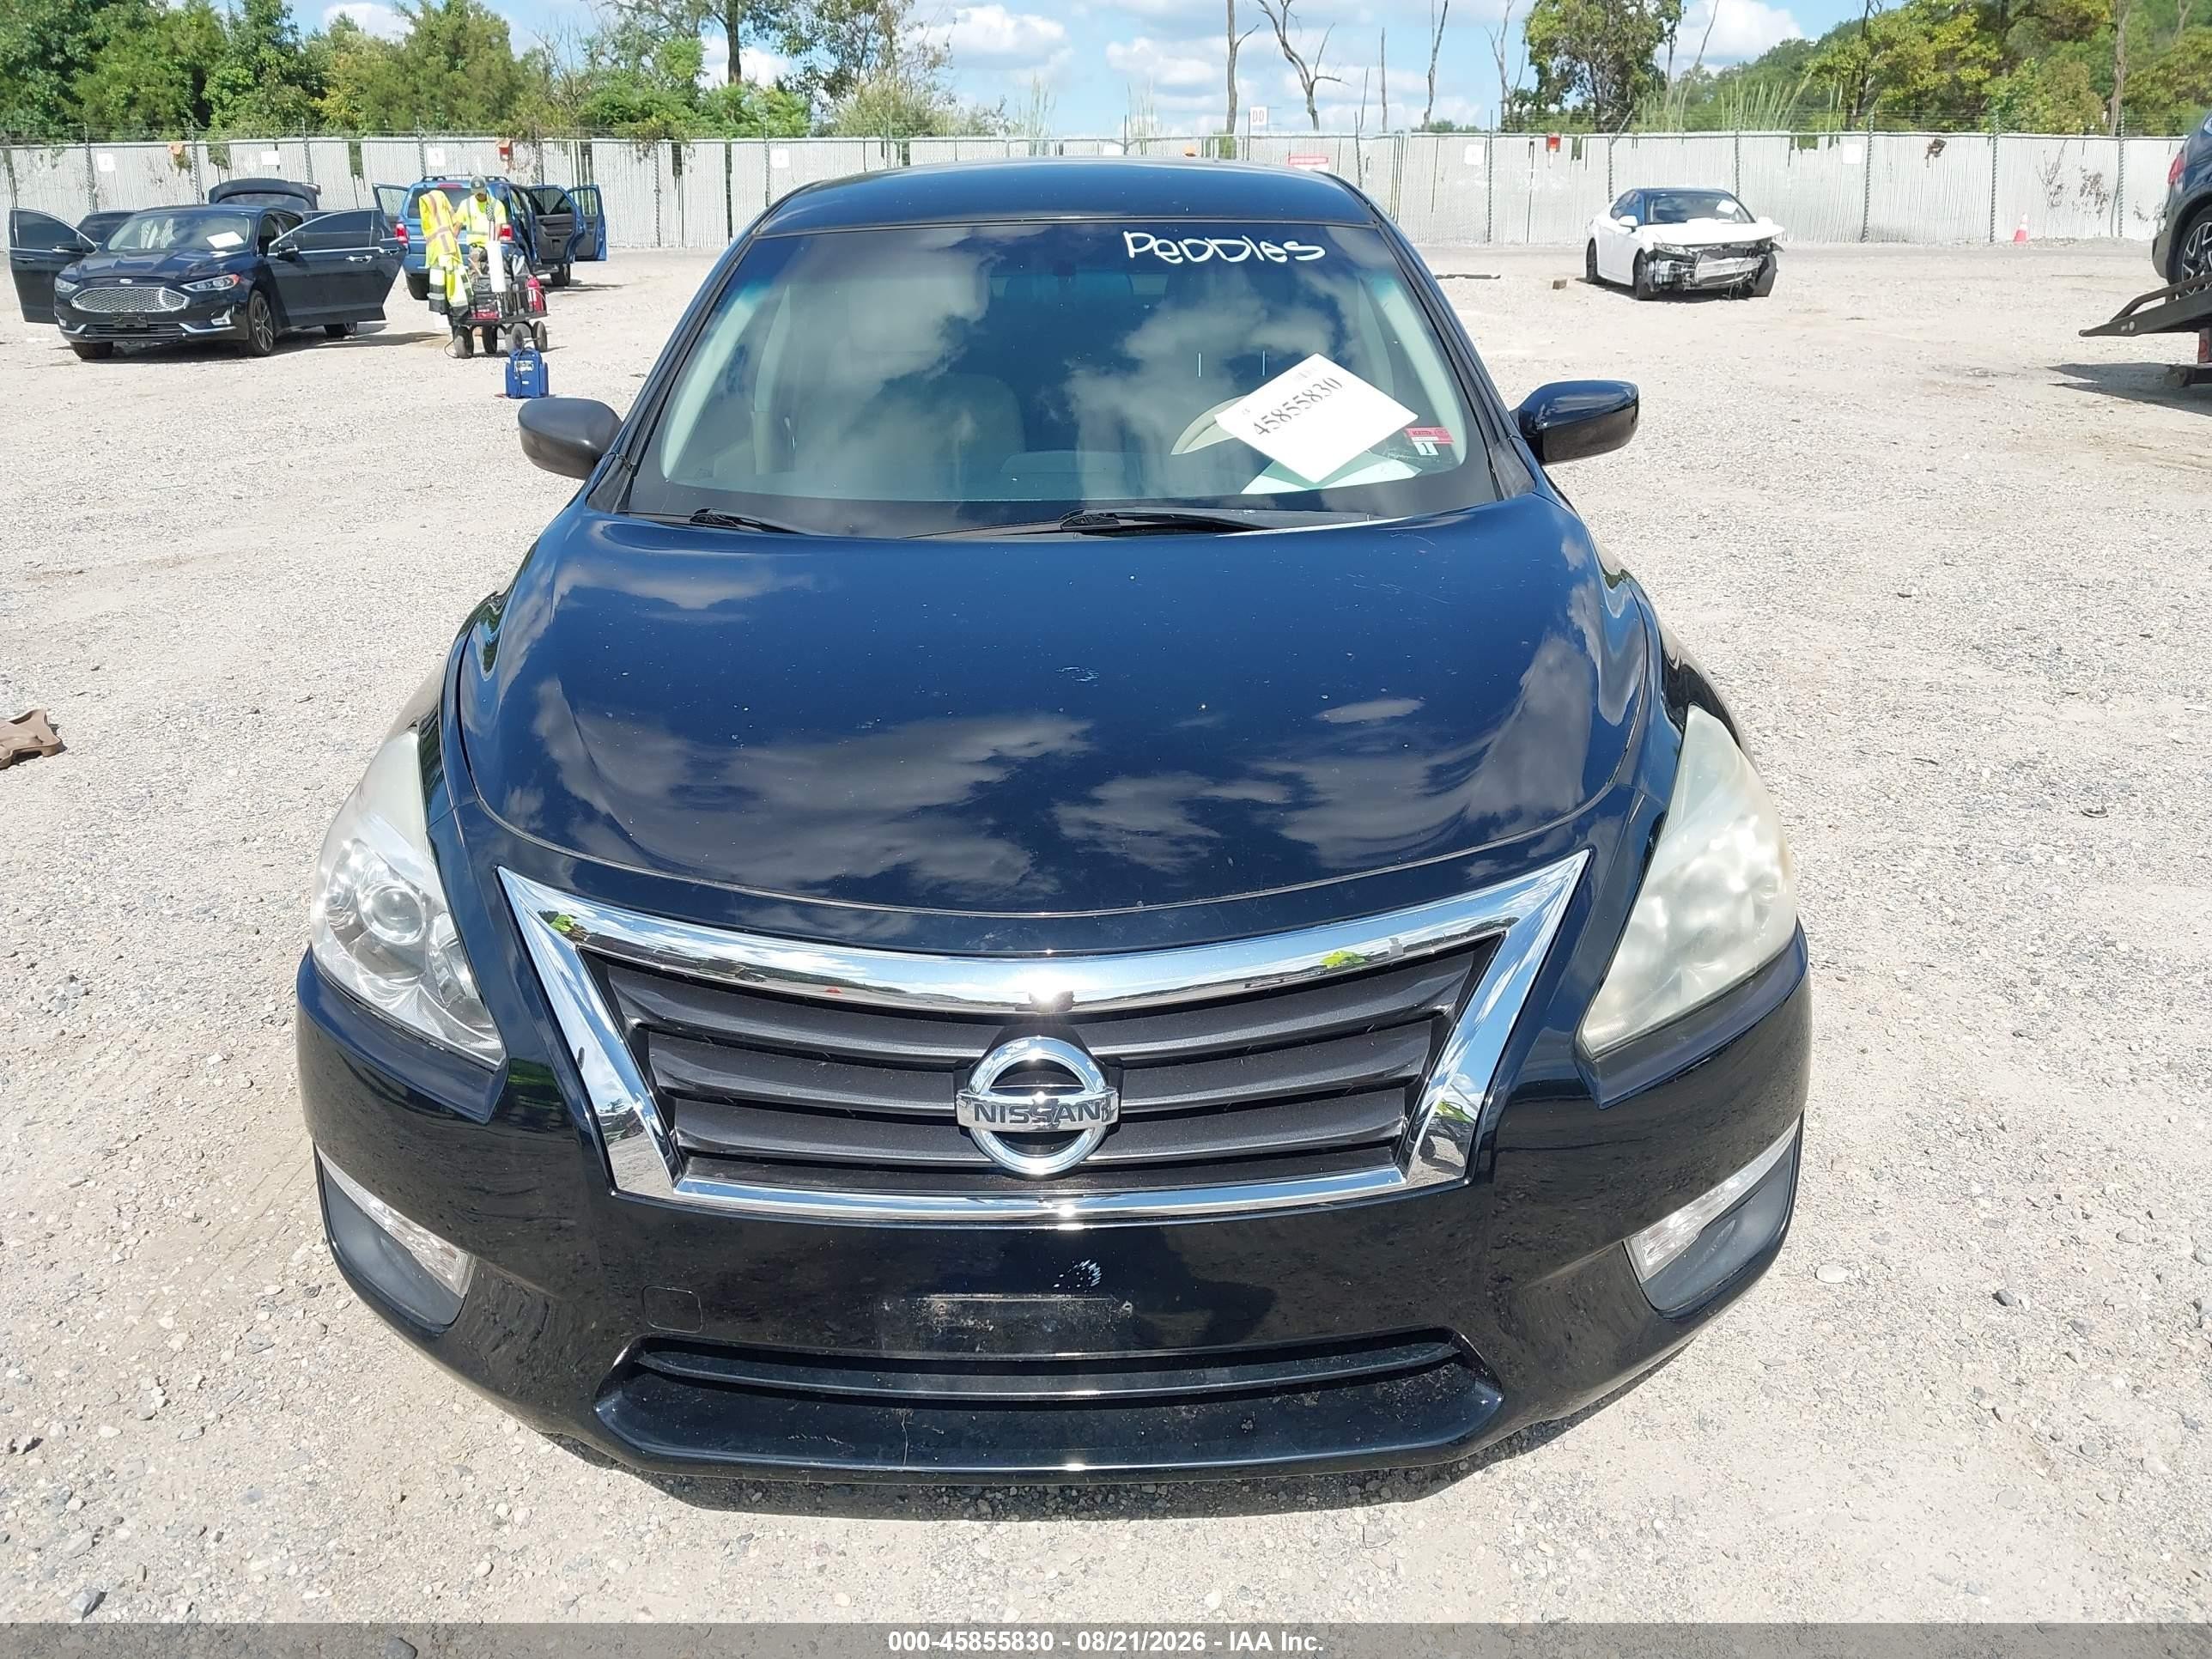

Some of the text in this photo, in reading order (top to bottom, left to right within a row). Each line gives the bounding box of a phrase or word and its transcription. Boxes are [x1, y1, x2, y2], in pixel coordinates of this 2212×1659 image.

[1253, 377, 1343, 435] 45855830
[1421, 442, 1433, 454] 1
[974, 1102, 1102, 1124] NISSAN
